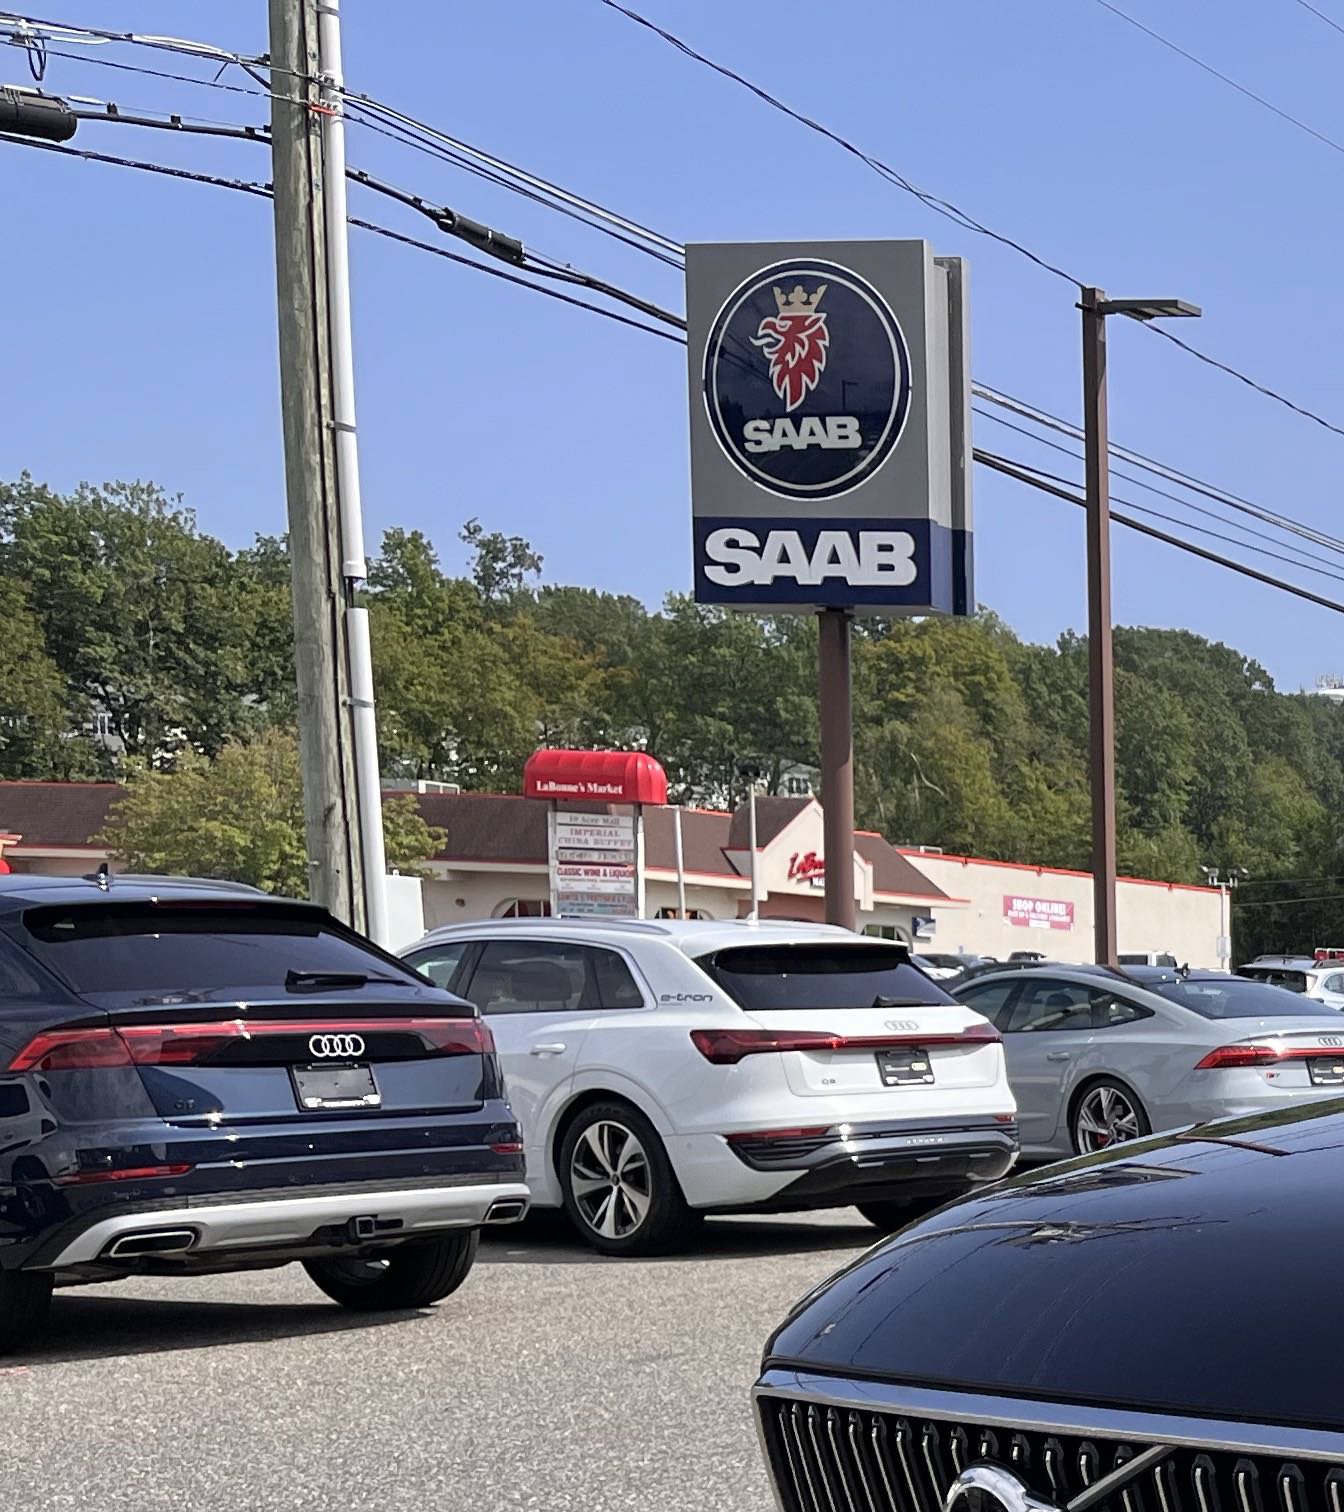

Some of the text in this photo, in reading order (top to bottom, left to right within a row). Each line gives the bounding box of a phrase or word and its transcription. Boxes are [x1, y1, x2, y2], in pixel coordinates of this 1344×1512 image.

[743, 416, 862, 453] SAAB
[704, 528, 917, 586] SAAB
[587, 782, 623, 794] Market
[570, 828, 620, 838] IMPERIAL
[557, 867, 582, 876] CLASSIC
[660, 993, 713, 1002] e-tron
